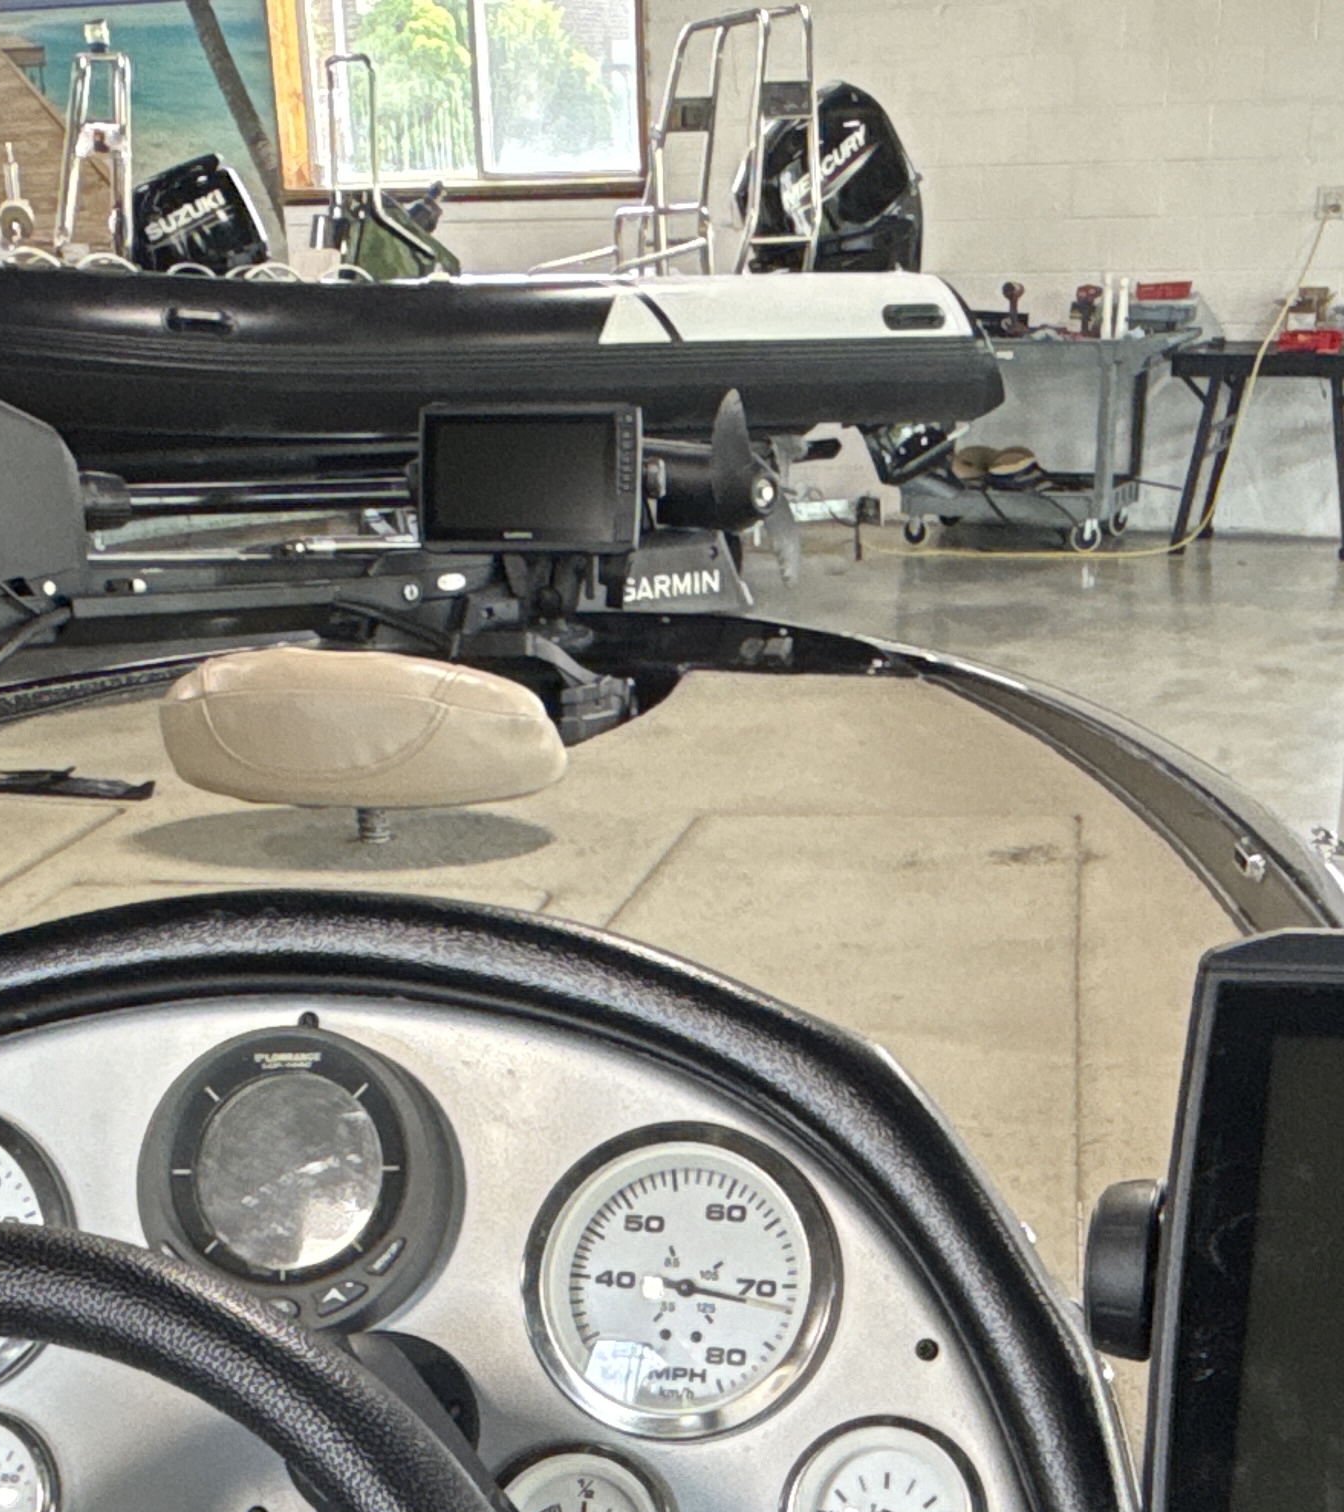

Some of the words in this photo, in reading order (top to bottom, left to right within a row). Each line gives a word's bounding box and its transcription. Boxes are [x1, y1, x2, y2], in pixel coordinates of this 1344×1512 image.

[783, 124, 867, 209] MECURY
[144, 189, 226, 241] SUZUKI
[705, 1203, 747, 1222] 60
[624, 1214, 665, 1233] 50
[594, 1270, 636, 1289] 40
[735, 1277, 777, 1298] 70
[705, 1347, 746, 1366] 80
[647, 1367, 707, 1383] MPH
[658, 1386, 695, 1400] km/h
